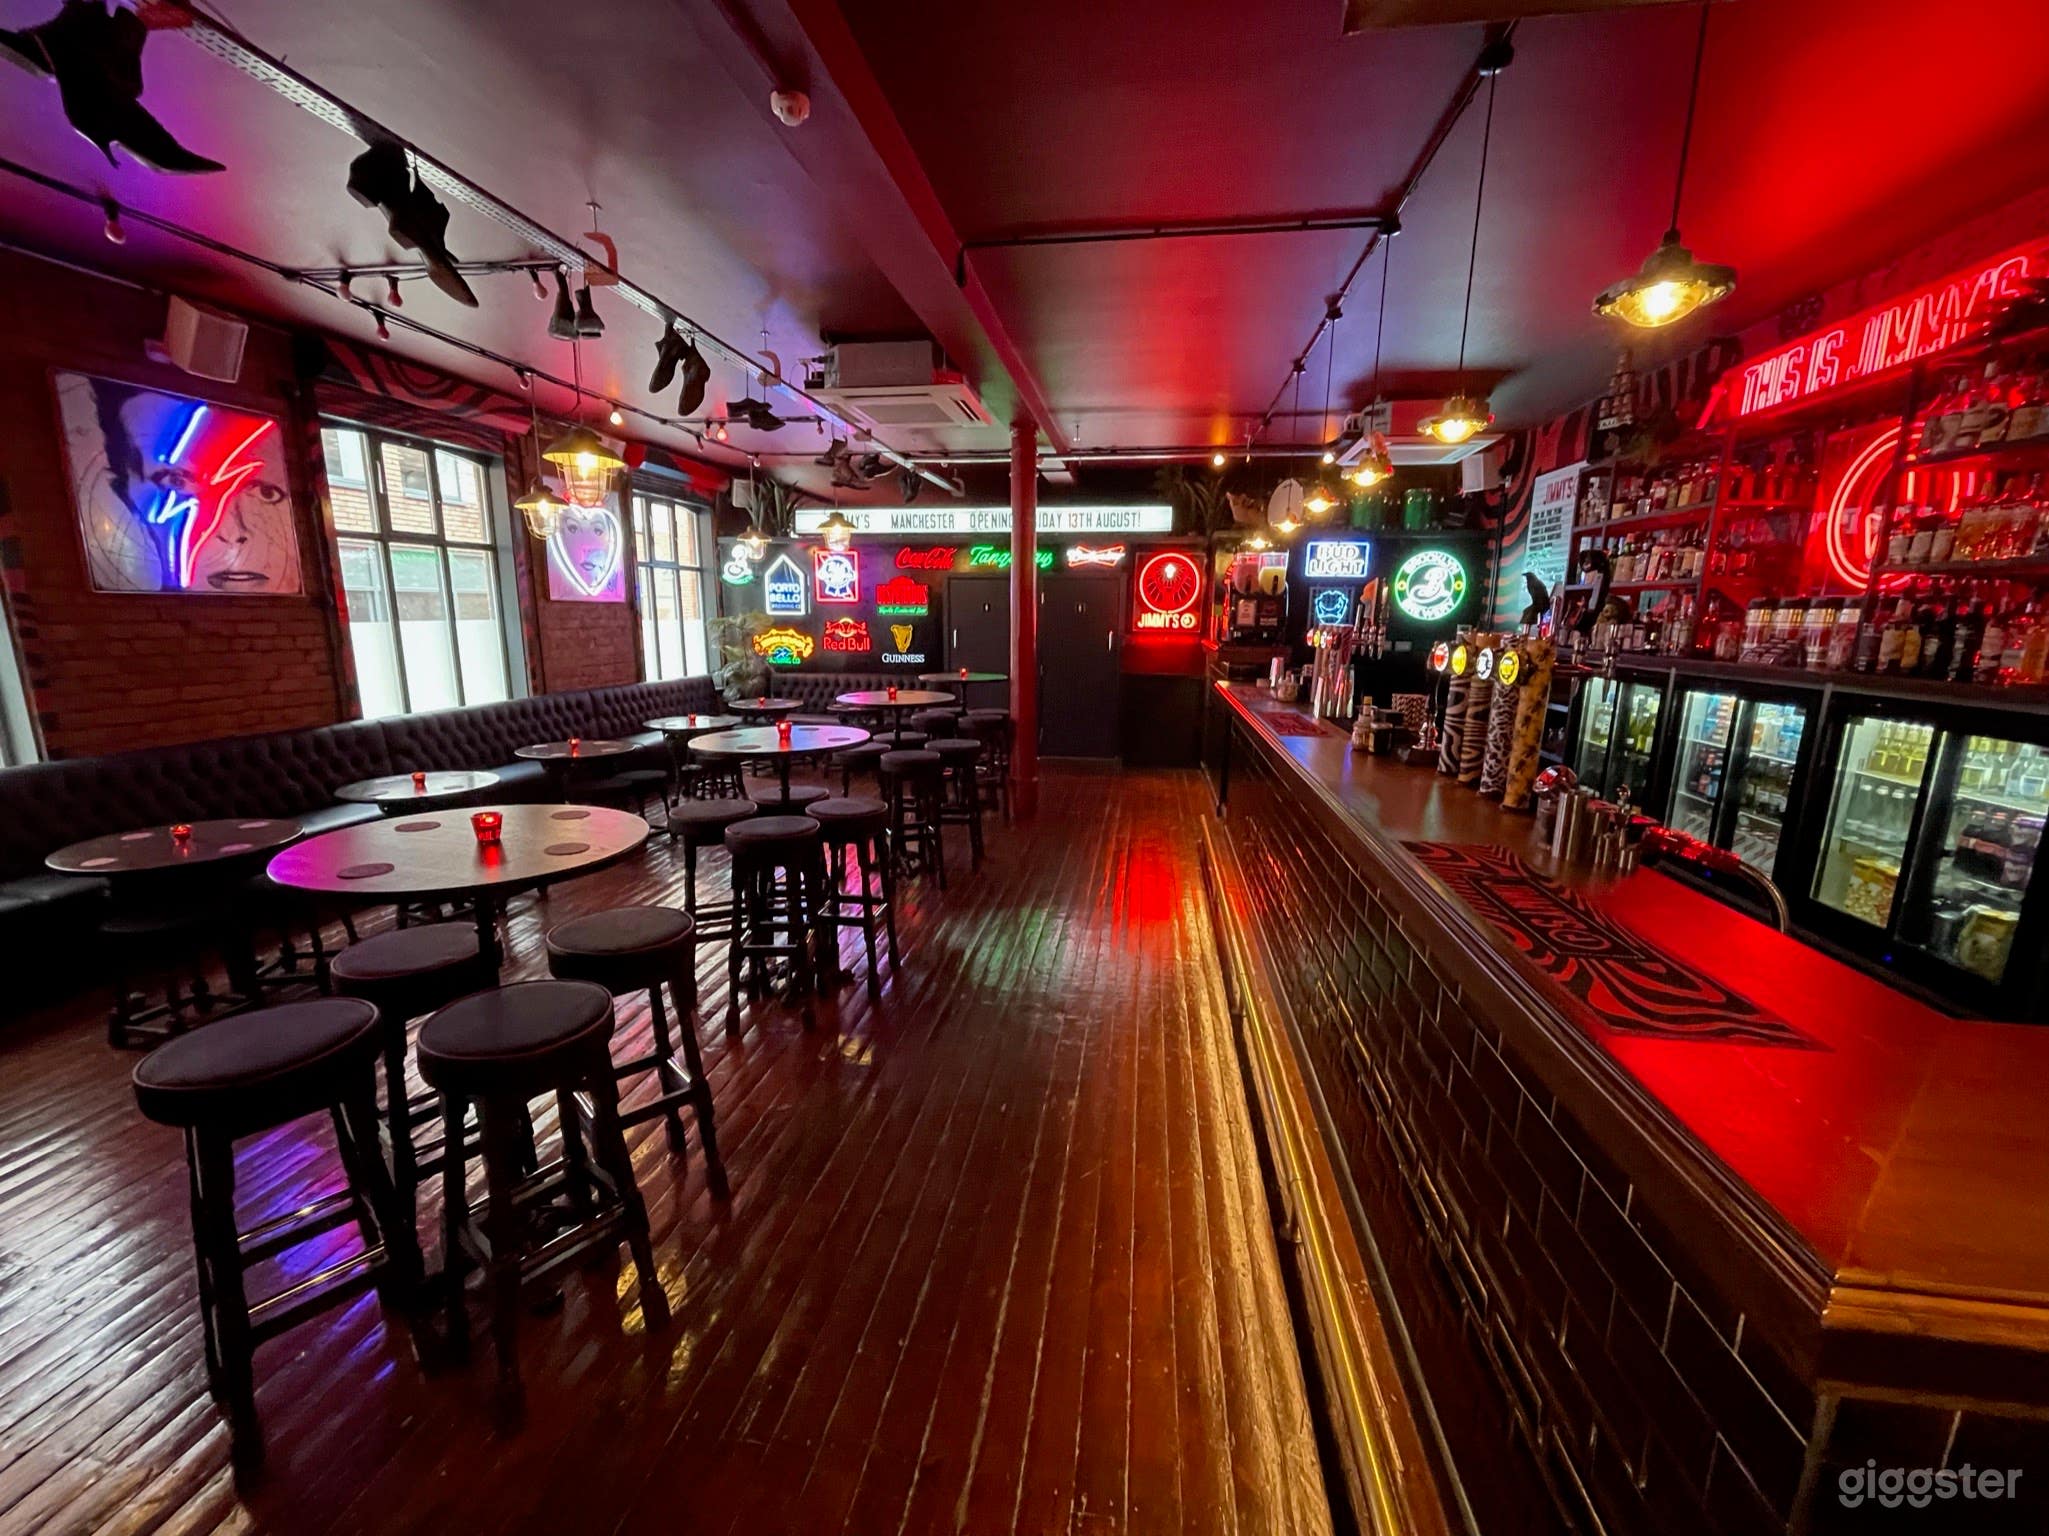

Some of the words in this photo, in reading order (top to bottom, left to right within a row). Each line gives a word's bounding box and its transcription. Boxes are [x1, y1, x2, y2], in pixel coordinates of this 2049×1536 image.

[1741, 346, 1805, 415] THIS
[1805, 329, 1845, 395] IS
[891, 513, 955, 529] MANCHESTER
[1068, 512, 1092, 529] 13TH
[1096, 511, 1141, 528] AUGUST!
[1317, 545, 1360, 560] BUD
[1309, 559, 1364, 575] LIGHT
[769, 582, 801, 593] PORTO
[769, 593, 801, 603] BELLO
[1137, 612, 1180, 629] JIMMY'S
[823, 637, 846, 651] Red
[848, 637, 871, 651] Bull
[881, 652, 926, 664] GUINNESS
